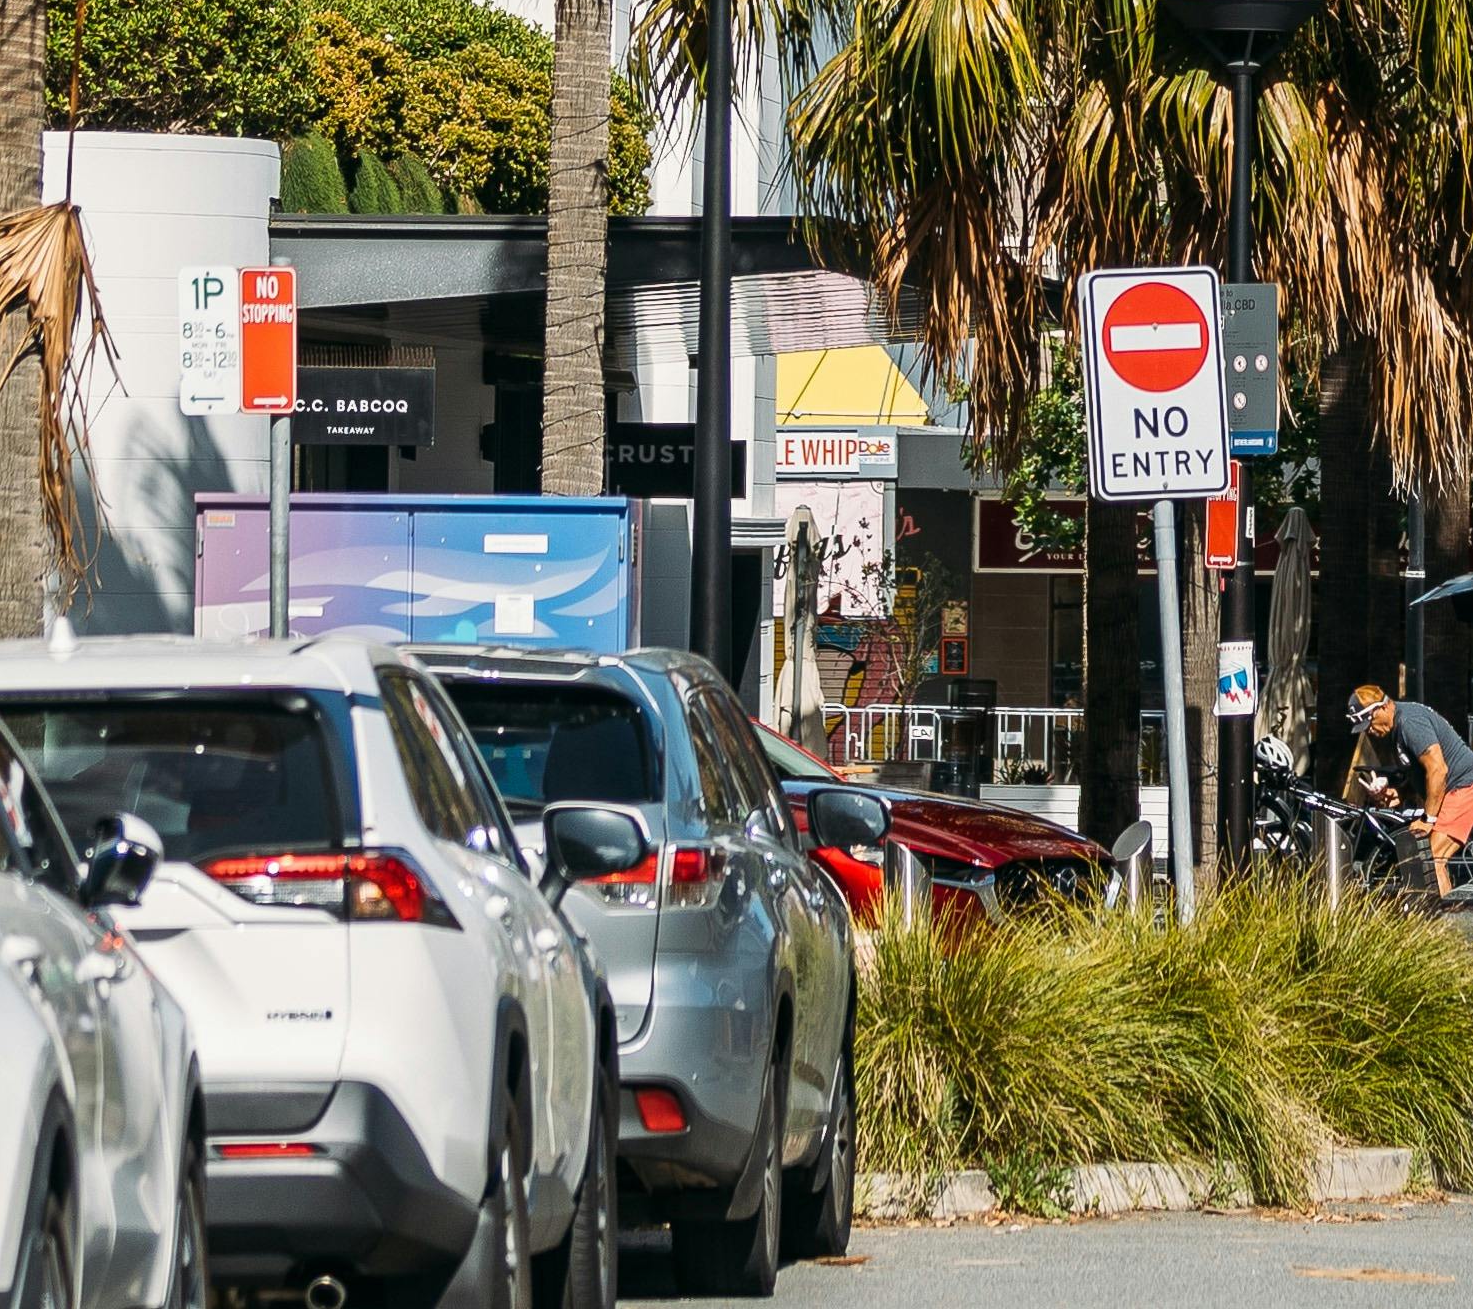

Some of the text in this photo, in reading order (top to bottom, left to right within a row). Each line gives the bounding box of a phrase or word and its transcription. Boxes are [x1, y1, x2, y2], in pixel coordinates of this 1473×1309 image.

[191, 277, 225, 310] 1P
[242, 275, 293, 323] NO STOPPING
[1234, 298, 1256, 312] CBD
[336, 399, 409, 414] BABCOQ
[326, 426, 376, 435] TAKEAWAY
[1133, 406, 1189, 439] NO
[801, 439, 858, 466] WHIP
[858, 440, 891, 454] Dole
[1111, 448, 1214, 478] ENTRY
[1046, 552, 1074, 561] YOUR
